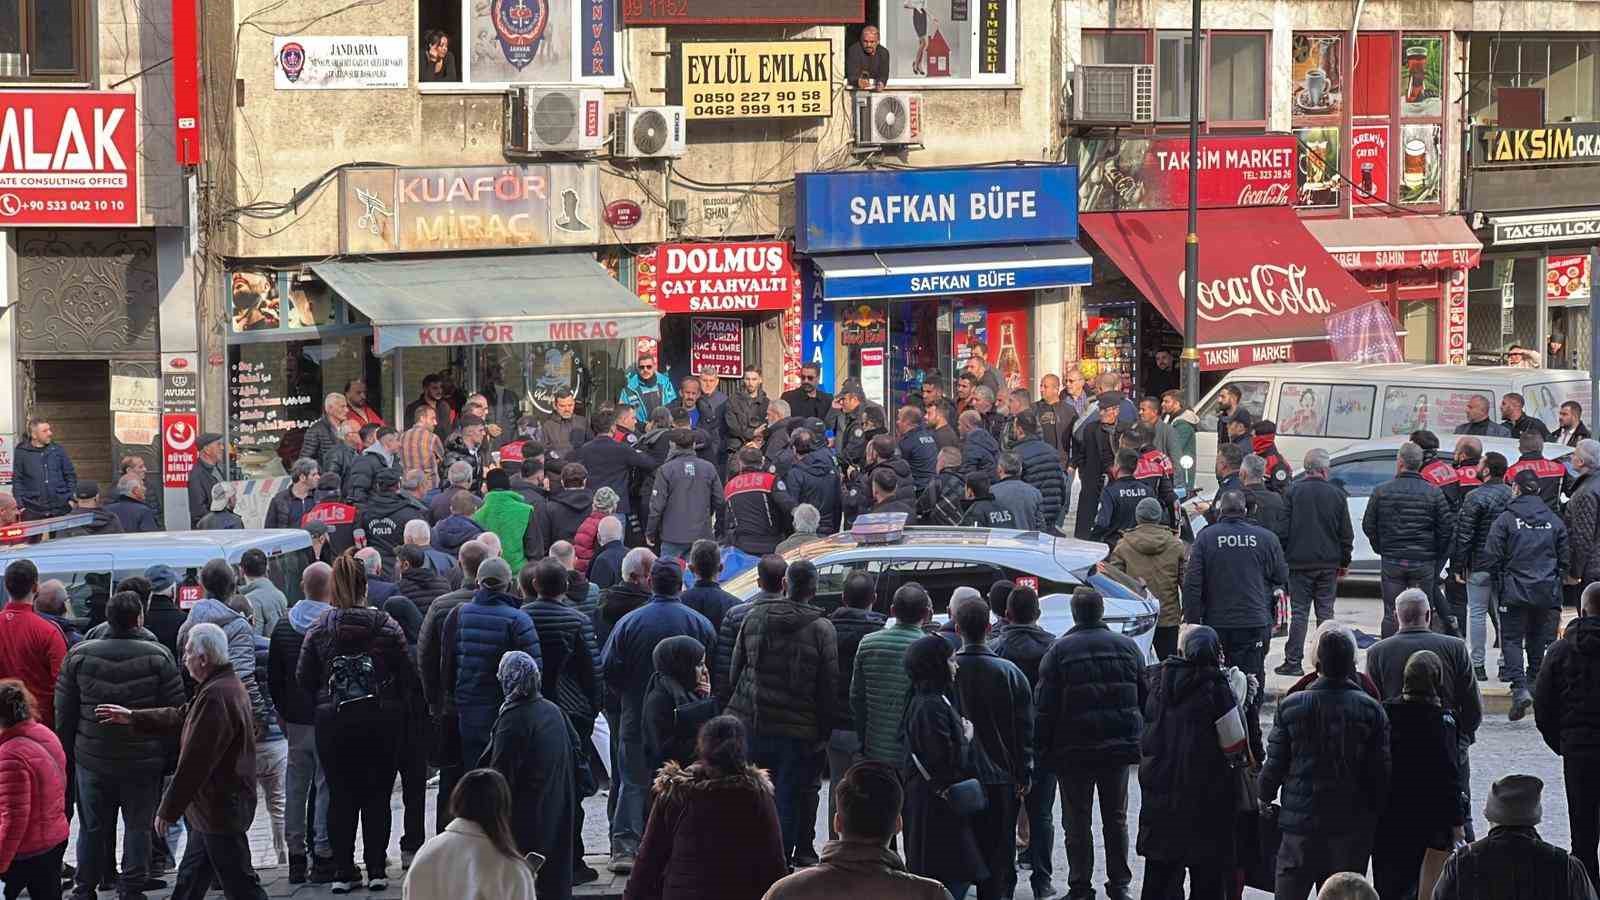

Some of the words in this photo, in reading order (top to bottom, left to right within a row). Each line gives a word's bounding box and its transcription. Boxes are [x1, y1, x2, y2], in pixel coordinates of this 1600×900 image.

[331, 43, 378, 55] JANDARMA
[688, 48, 750, 84] EYLÜL
[759, 53, 827, 83] EMLAK
[694, 92, 734, 103] 0850
[741, 92, 770, 102] 227
[776, 91, 796, 101] 90
[801, 90, 821, 100] 58
[694, 104, 735, 116] 0462
[741, 104, 770, 114] 999
[777, 104, 795, 113] 11
[801, 103, 821, 113] 52
[909, 97, 918, 138] VESTEL
[1484, 128, 1571, 160] TAKSİM
[1226, 149, 1292, 168] MARKET
[20, 177, 85, 185] CONSULTING
[89, 177, 124, 185] OFFICE
[400, 171, 546, 203] KUAFÖR
[21, 200, 44, 211] +90
[47, 200, 67, 211] 533
[70, 200, 91, 211] 042
[94, 200, 108, 210] 10
[112, 200, 124, 210] 10
[850, 193, 955, 225] SAFKAN
[970, 185, 1036, 220] BÜFE
[1504, 223, 1562, 239] TAKSİM
[666, 247, 783, 275] DOLMUŞ
[661, 280, 698, 298] ÇAY
[700, 277, 787, 294] KAHVALTI
[911, 275, 970, 292] SAFKAN
[978, 271, 1015, 287] BÜFE
[690, 294, 760, 310] SALONU
[419, 322, 513, 345] KUAFÖR
[707, 321, 739, 331] FARAN
[711, 342, 717, 351] &
[719, 344, 741, 352] UMRE
[1204, 346, 1239, 366] TAKSİM
[1252, 344, 1292, 361] MARKET
[164, 389, 196, 397] AVUKAT
[168, 453, 193, 462] BÜYÜK
[166, 472, 188, 482] PARTİ
[1120, 487, 1146, 497] POLİS
[307, 506, 346, 522] POLİS
[1217, 534, 1257, 547] POLİS
[183, 588, 198, 600] 112
